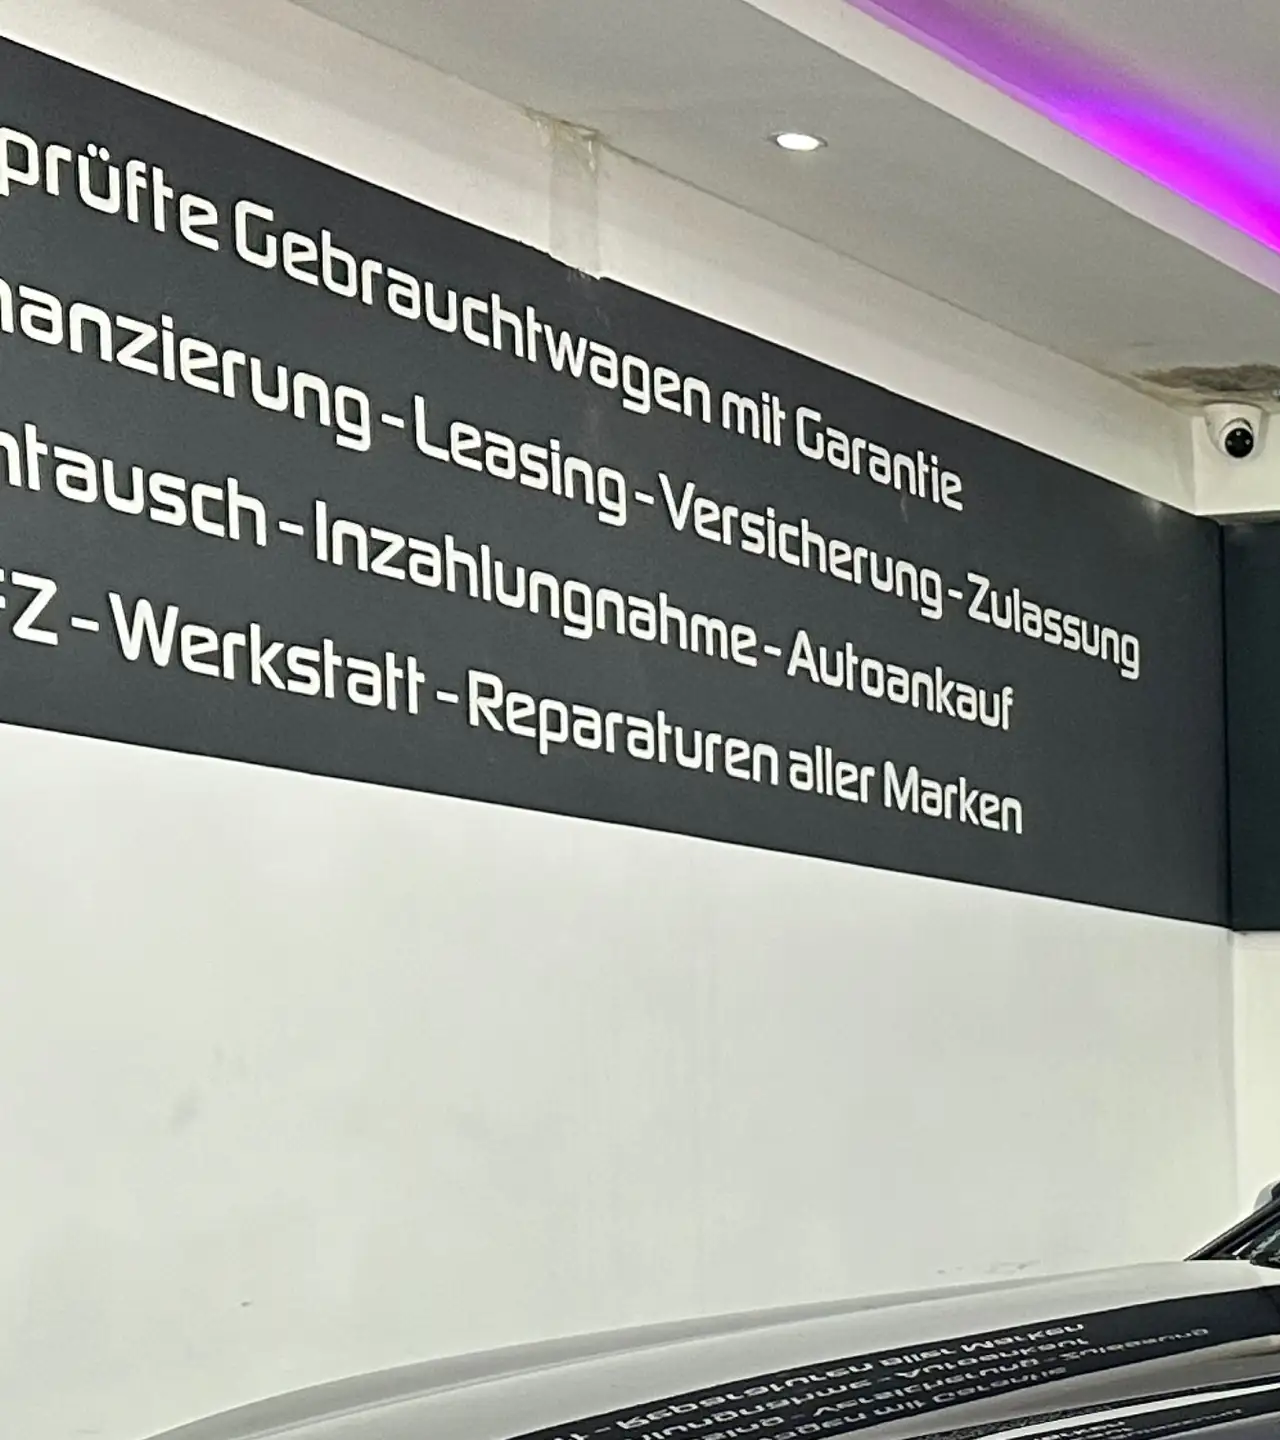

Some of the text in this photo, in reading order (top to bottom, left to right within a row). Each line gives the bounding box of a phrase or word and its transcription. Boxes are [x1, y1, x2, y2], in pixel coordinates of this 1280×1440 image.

[0, 126, 964, 511] prüfte Gebrauchtwagen mit Garantie
[315, 499, 757, 667] Inzahlungnahme
[786, 630, 1014, 731] Autoankauf
[414, 394, 627, 527] Leasing
[658, 472, 943, 619] Versicherung
[967, 572, 1139, 680] Zulassung
[0, 567, 58, 646] Z
[108, 592, 426, 715] Werkstatt
[468, 669, 778, 786] Reparaturen
[788, 744, 875, 803] aller
[884, 760, 1023, 835] Marken
